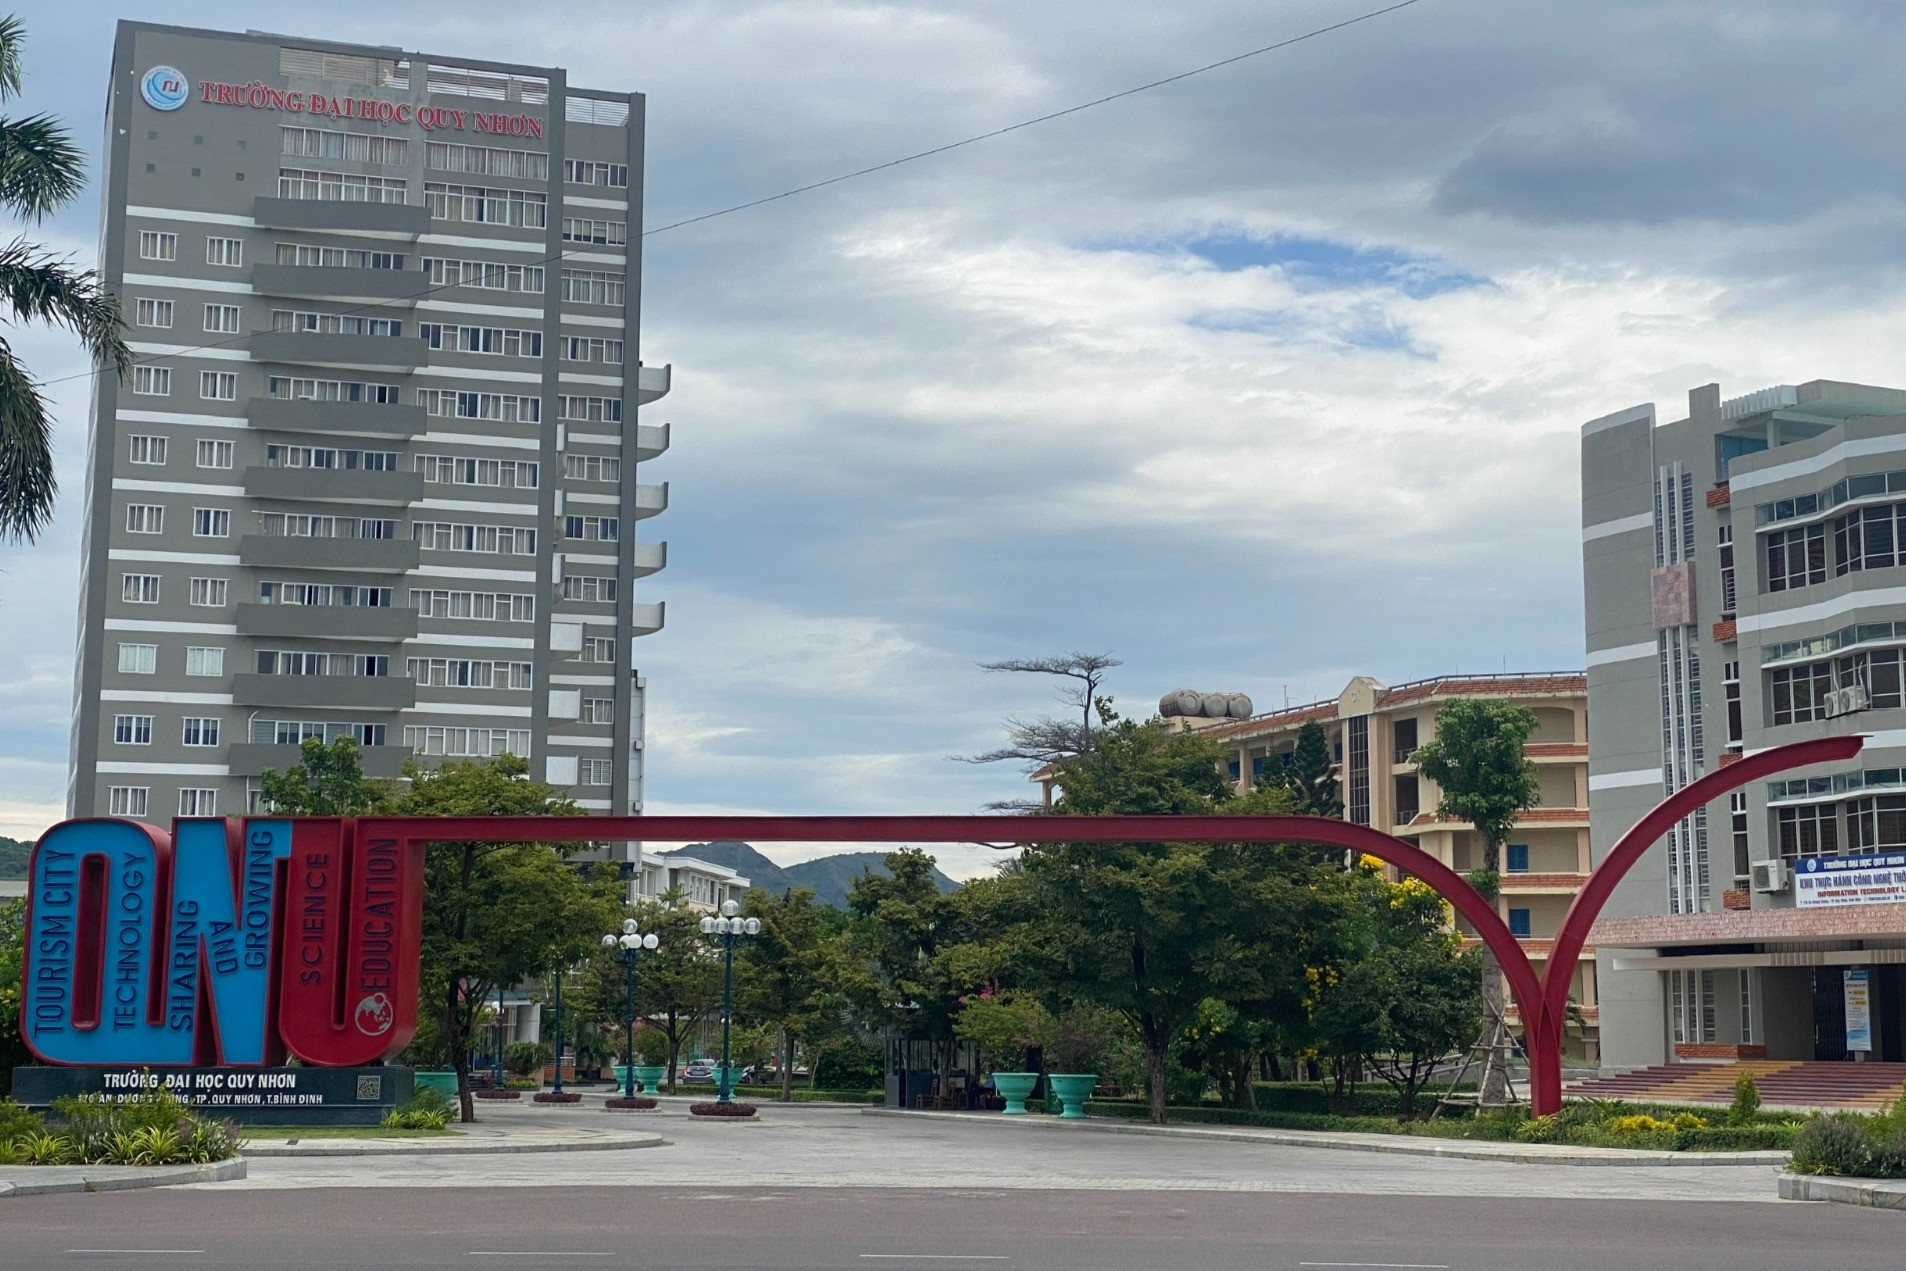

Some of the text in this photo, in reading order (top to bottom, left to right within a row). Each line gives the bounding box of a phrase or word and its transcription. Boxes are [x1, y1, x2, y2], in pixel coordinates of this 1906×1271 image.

[199, 79, 543, 138] TRƯỜNG ĐẠI HỌC QUY NHƠN
[33, 849, 75, 1038] TOURISM CITY
[113, 851, 146, 1032] TECHNOLOGY
[244, 830, 274, 969] GROWING
[301, 852, 330, 986] SCIENCE
[361, 838, 398, 992] EDUCATION
[1817, 889, 1858, 898] INFORMATION
[1860, 886, 1900, 895] TECHNOLOGY
[1833, 874, 1852, 888] HÀNH
[170, 900, 199, 1033] SHARING
[209, 920, 239, 976] AND
[103, 1069, 296, 1093] TRƯỜNG ĐẠI HỌC QUY NHƠN
